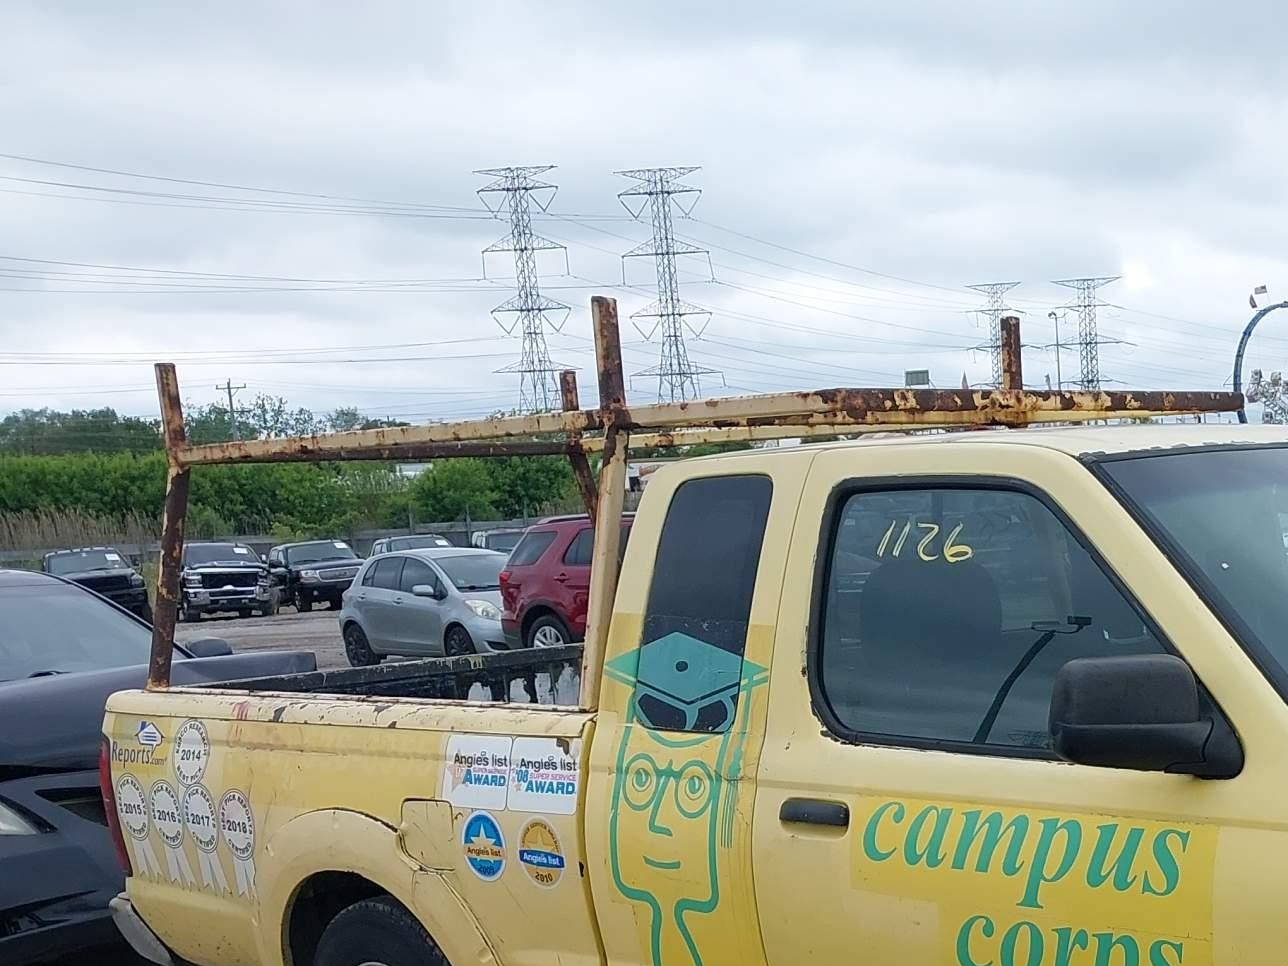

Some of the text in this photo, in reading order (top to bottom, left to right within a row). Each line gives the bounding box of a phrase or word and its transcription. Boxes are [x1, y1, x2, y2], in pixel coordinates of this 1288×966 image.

[877, 520, 974, 562] 1126
[180, 749, 201, 760] 2014
[492, 753, 508, 767] list
[560, 758, 577, 771] list
[462, 769, 506, 786] AWARD
[525, 780, 576, 794] AWARD
[123, 803, 142, 814] 2015
[157, 810, 177, 822] 2016
[191, 813, 210, 826] 2017
[227, 820, 247, 833] 2018
[490, 848, 502, 857] list
[862, 800, 1191, 909] campus
[548, 857, 561, 866] list
[535, 871, 553, 883] 2010
